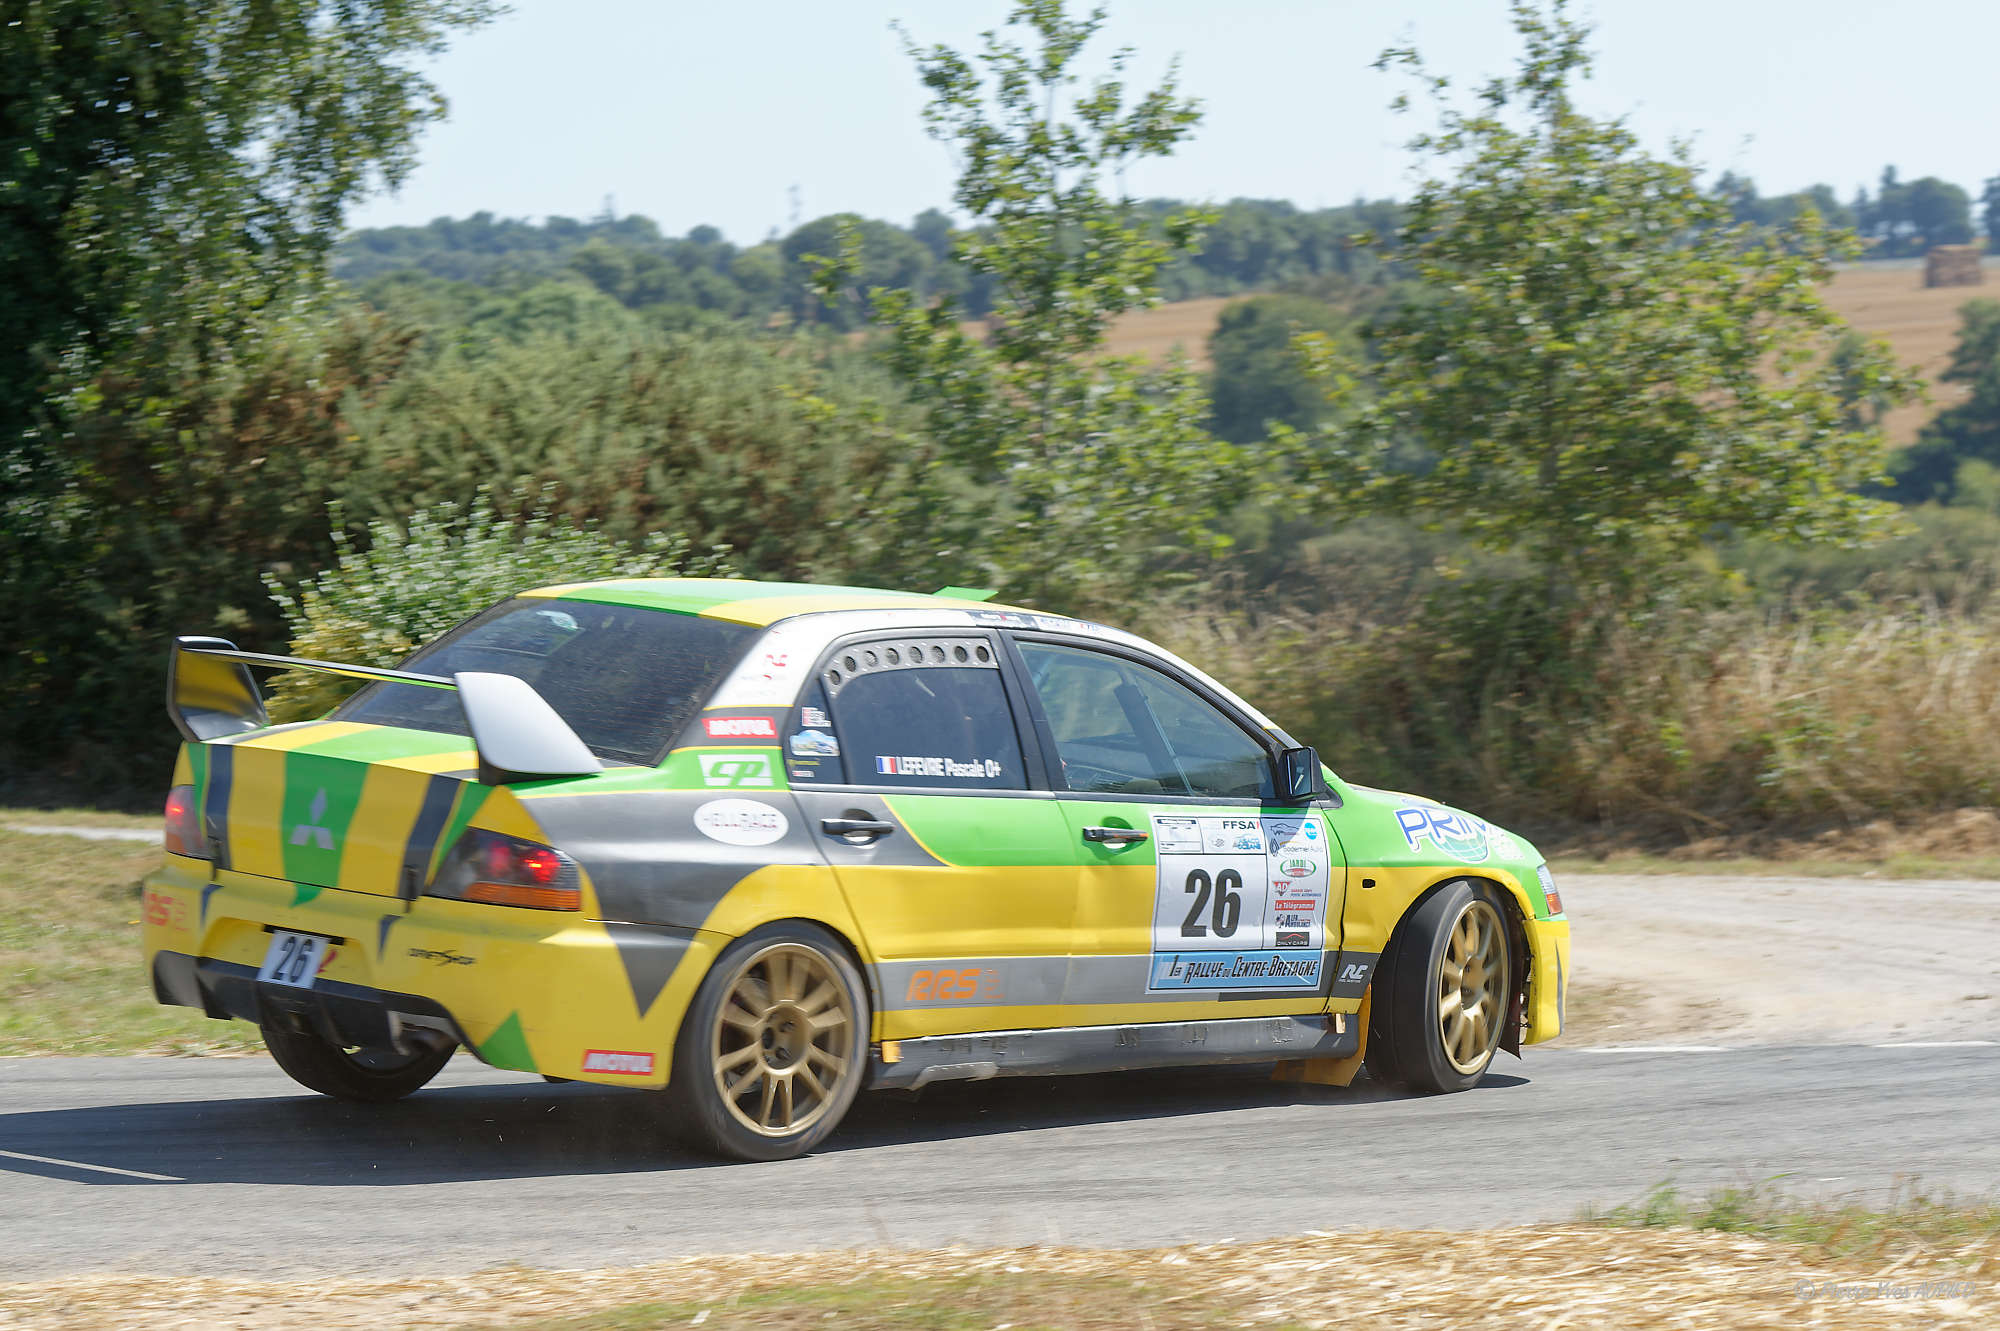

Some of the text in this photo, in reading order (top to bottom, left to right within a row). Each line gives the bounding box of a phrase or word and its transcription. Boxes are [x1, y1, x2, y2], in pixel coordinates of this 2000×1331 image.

[1222, 820, 1256, 830] FFSA
[1180, 868, 1243, 938] 26
[272, 936, 313, 983] 26
[1184, 962, 1223, 984] RALLYE
